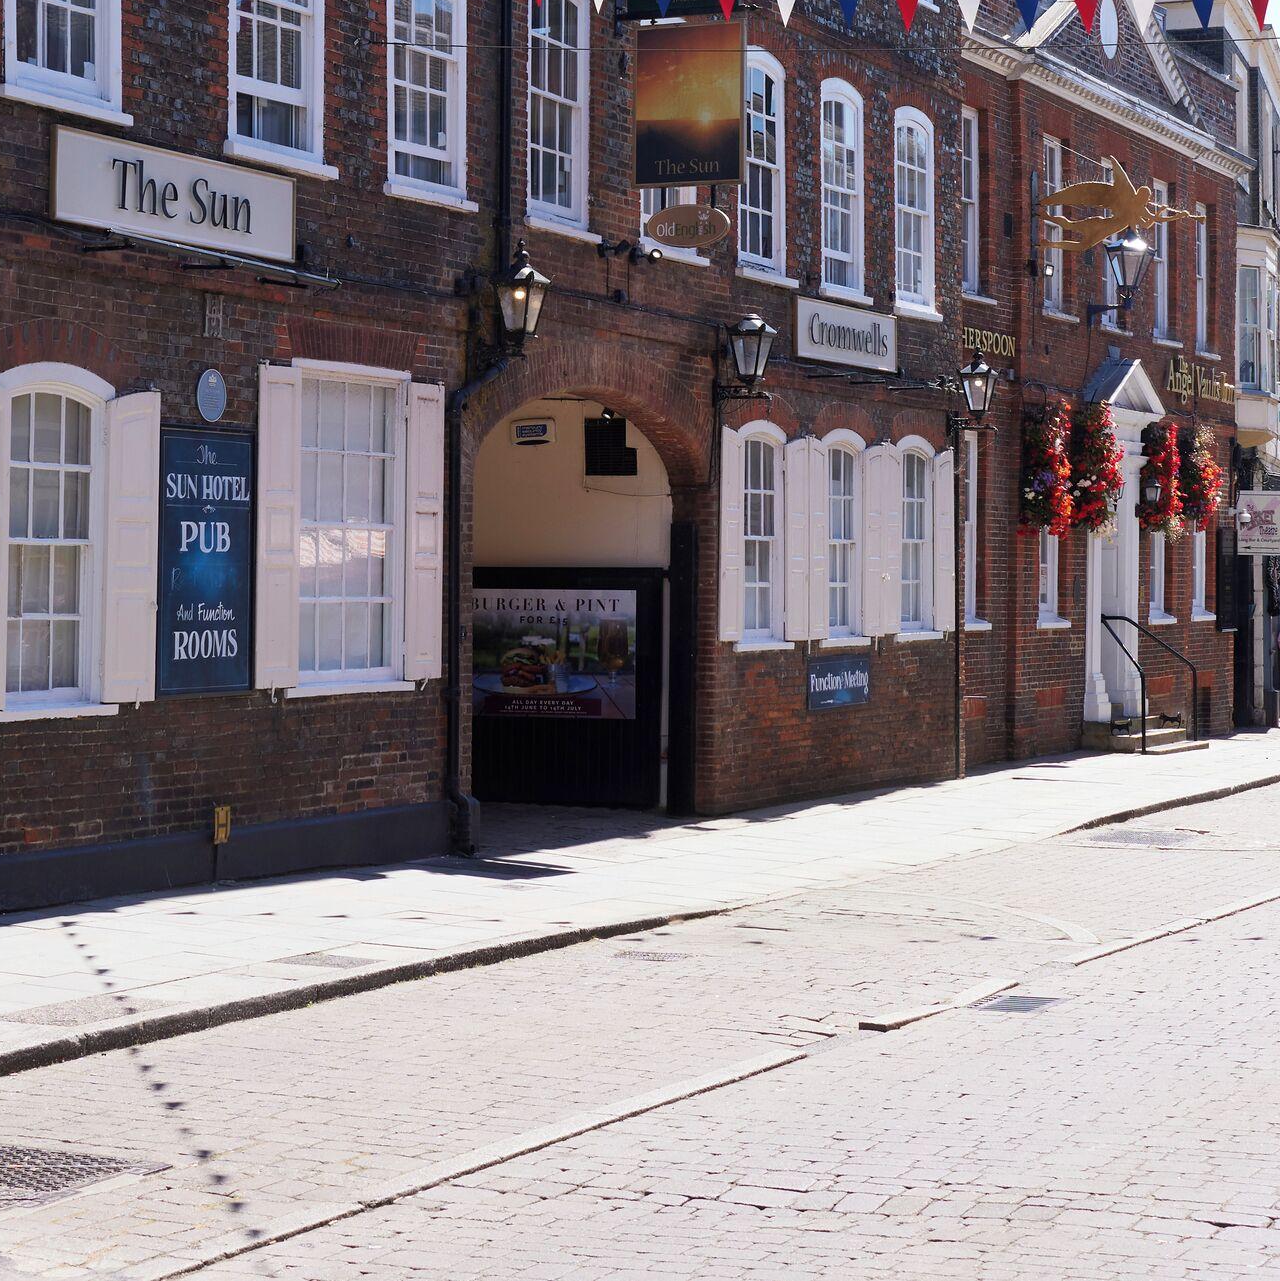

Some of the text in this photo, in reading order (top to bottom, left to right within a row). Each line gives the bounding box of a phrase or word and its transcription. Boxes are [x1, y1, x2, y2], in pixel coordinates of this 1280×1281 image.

[654, 158, 719, 176] The Sun
[112, 157, 253, 235] The Sun
[808, 311, 888, 358] Cromwells
[1166, 359, 1195, 405] Angel
[1195, 365, 1221, 402] Vaults
[196, 444, 218, 465] The
[166, 473, 250, 502] SUN HOTEL
[180, 521, 231, 554] PUB
[176, 600, 236, 622] And Function
[472, 597, 621, 612] BURGER & PINT
[520, 615, 543, 625] FOR
[173, 629, 239, 661] ROOMS
[810, 672, 841, 693] Function
[844, 669, 869, 694] Meeting
